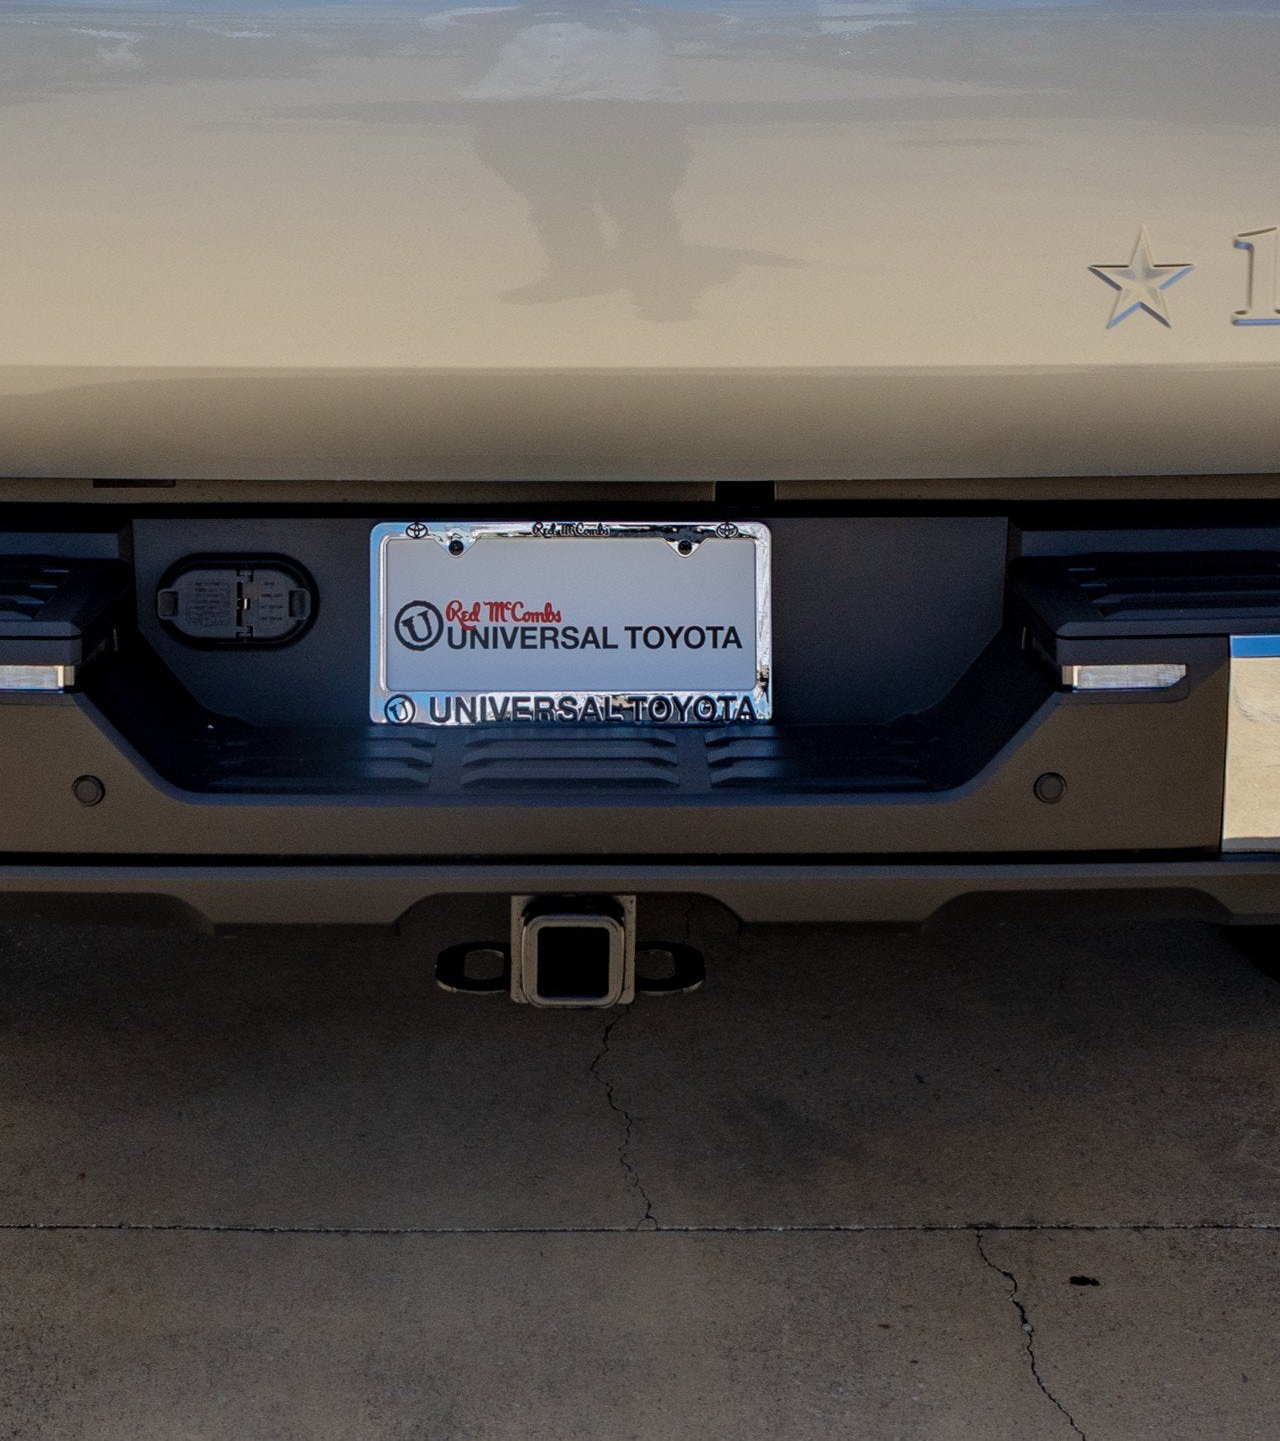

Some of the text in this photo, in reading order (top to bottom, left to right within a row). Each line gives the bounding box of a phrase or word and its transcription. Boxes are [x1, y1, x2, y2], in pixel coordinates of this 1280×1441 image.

[445, 600, 562, 631] Red McCombs
[447, 625, 618, 650] UNIVERSAL
[624, 625, 743, 650] TOYOTA
[429, 695, 624, 724] UNIVERSAL
[629, 694, 758, 724] TOYOTA
